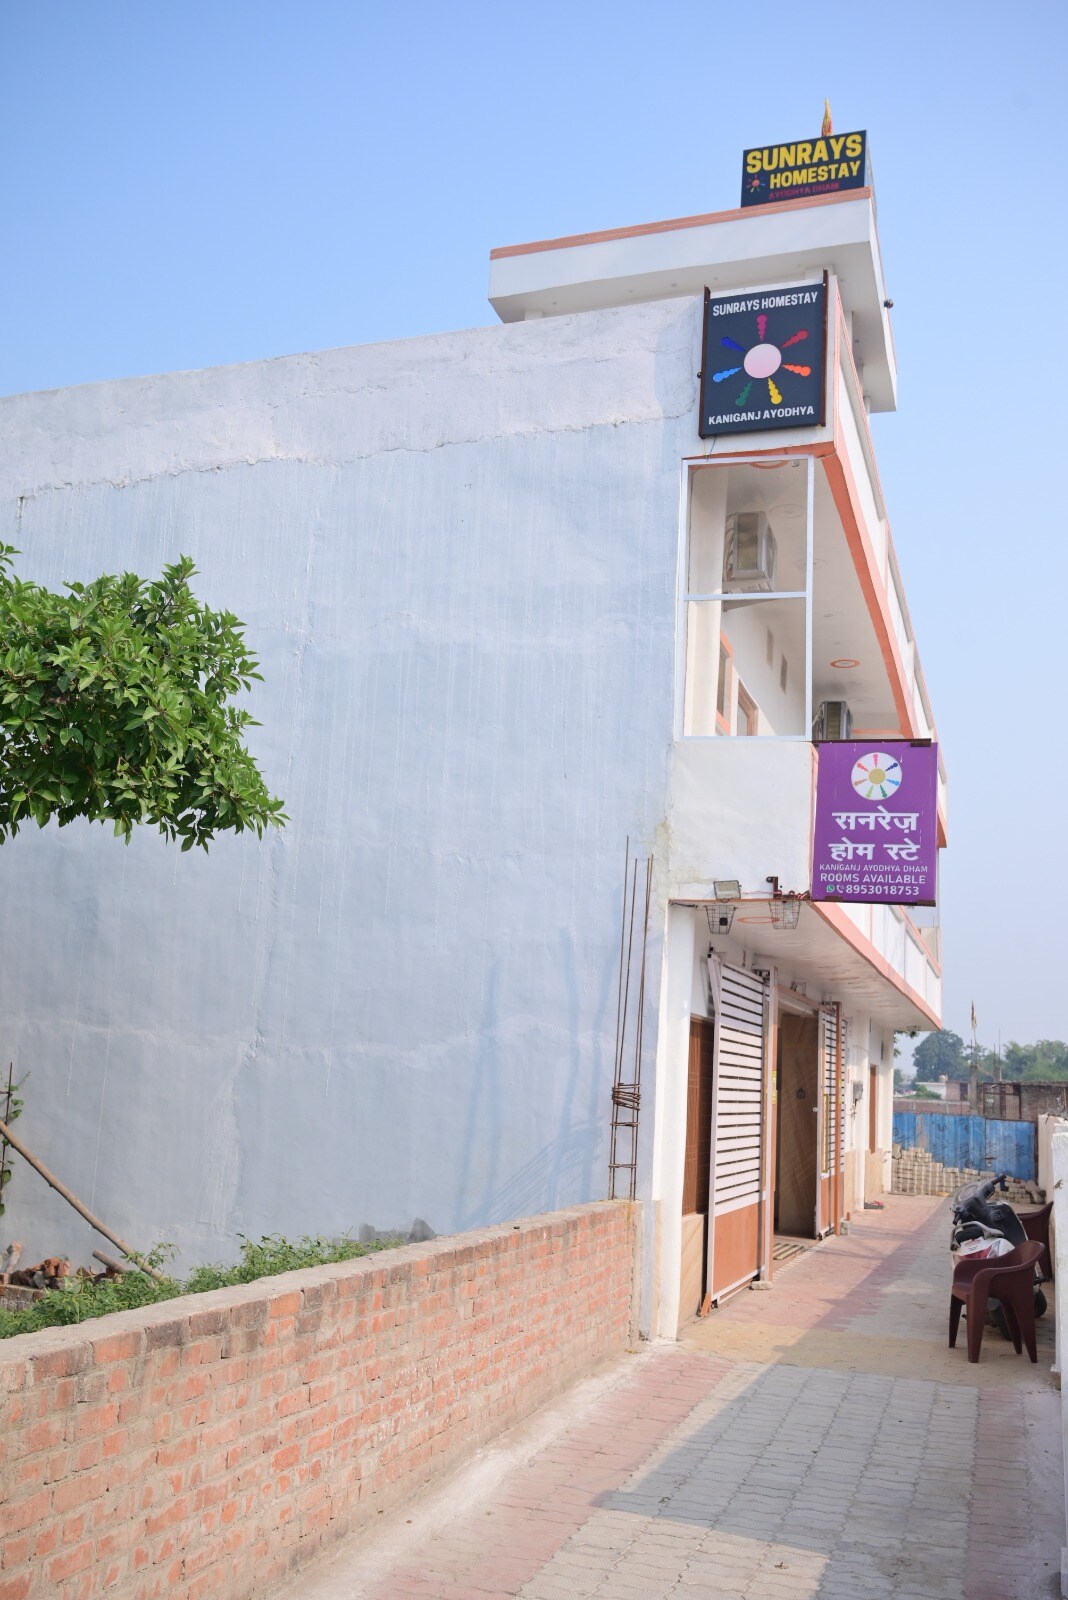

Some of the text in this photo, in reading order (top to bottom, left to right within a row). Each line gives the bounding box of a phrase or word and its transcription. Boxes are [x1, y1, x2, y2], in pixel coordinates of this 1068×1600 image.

[746, 134, 862, 174] SUNRAYS
[769, 160, 861, 189] HOMESTAY
[712, 291, 818, 317] SUNRAYS HOMESTAY
[708, 405, 815, 426] KANIGANJ AYODHYA
[831, 805, 920, 834] सनरेज़
[828, 836, 921, 862] होम स्टे
[819, 863, 928, 873] KANIGANJ AYODHYA DHAM
[820, 873, 926, 885] ROOMS AVAILABLE
[845, 884, 920, 896] 8953018753
